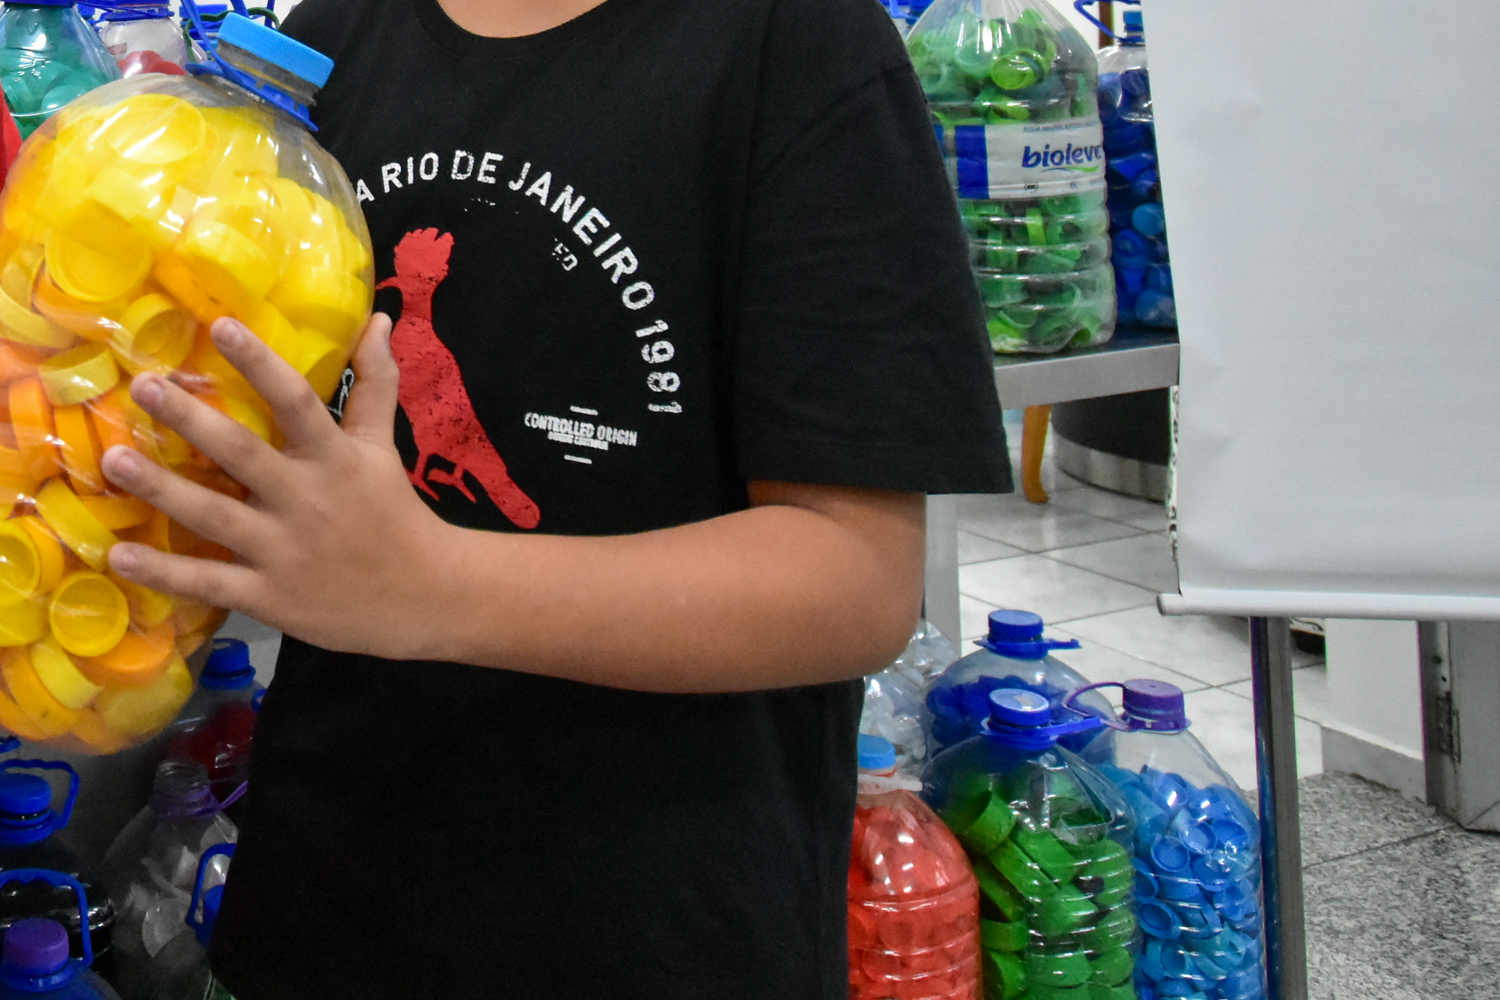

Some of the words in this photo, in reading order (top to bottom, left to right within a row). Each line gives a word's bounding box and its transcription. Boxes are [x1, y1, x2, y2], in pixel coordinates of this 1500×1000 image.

[382, 152, 439, 193] RIO
[450, 150, 504, 184] DE
[508, 162, 655, 311] JANEIRO
[635, 319, 682, 414] 1981
[524, 412, 595, 438] CONTROLLED
[597, 425, 638, 447] ORIGIN
